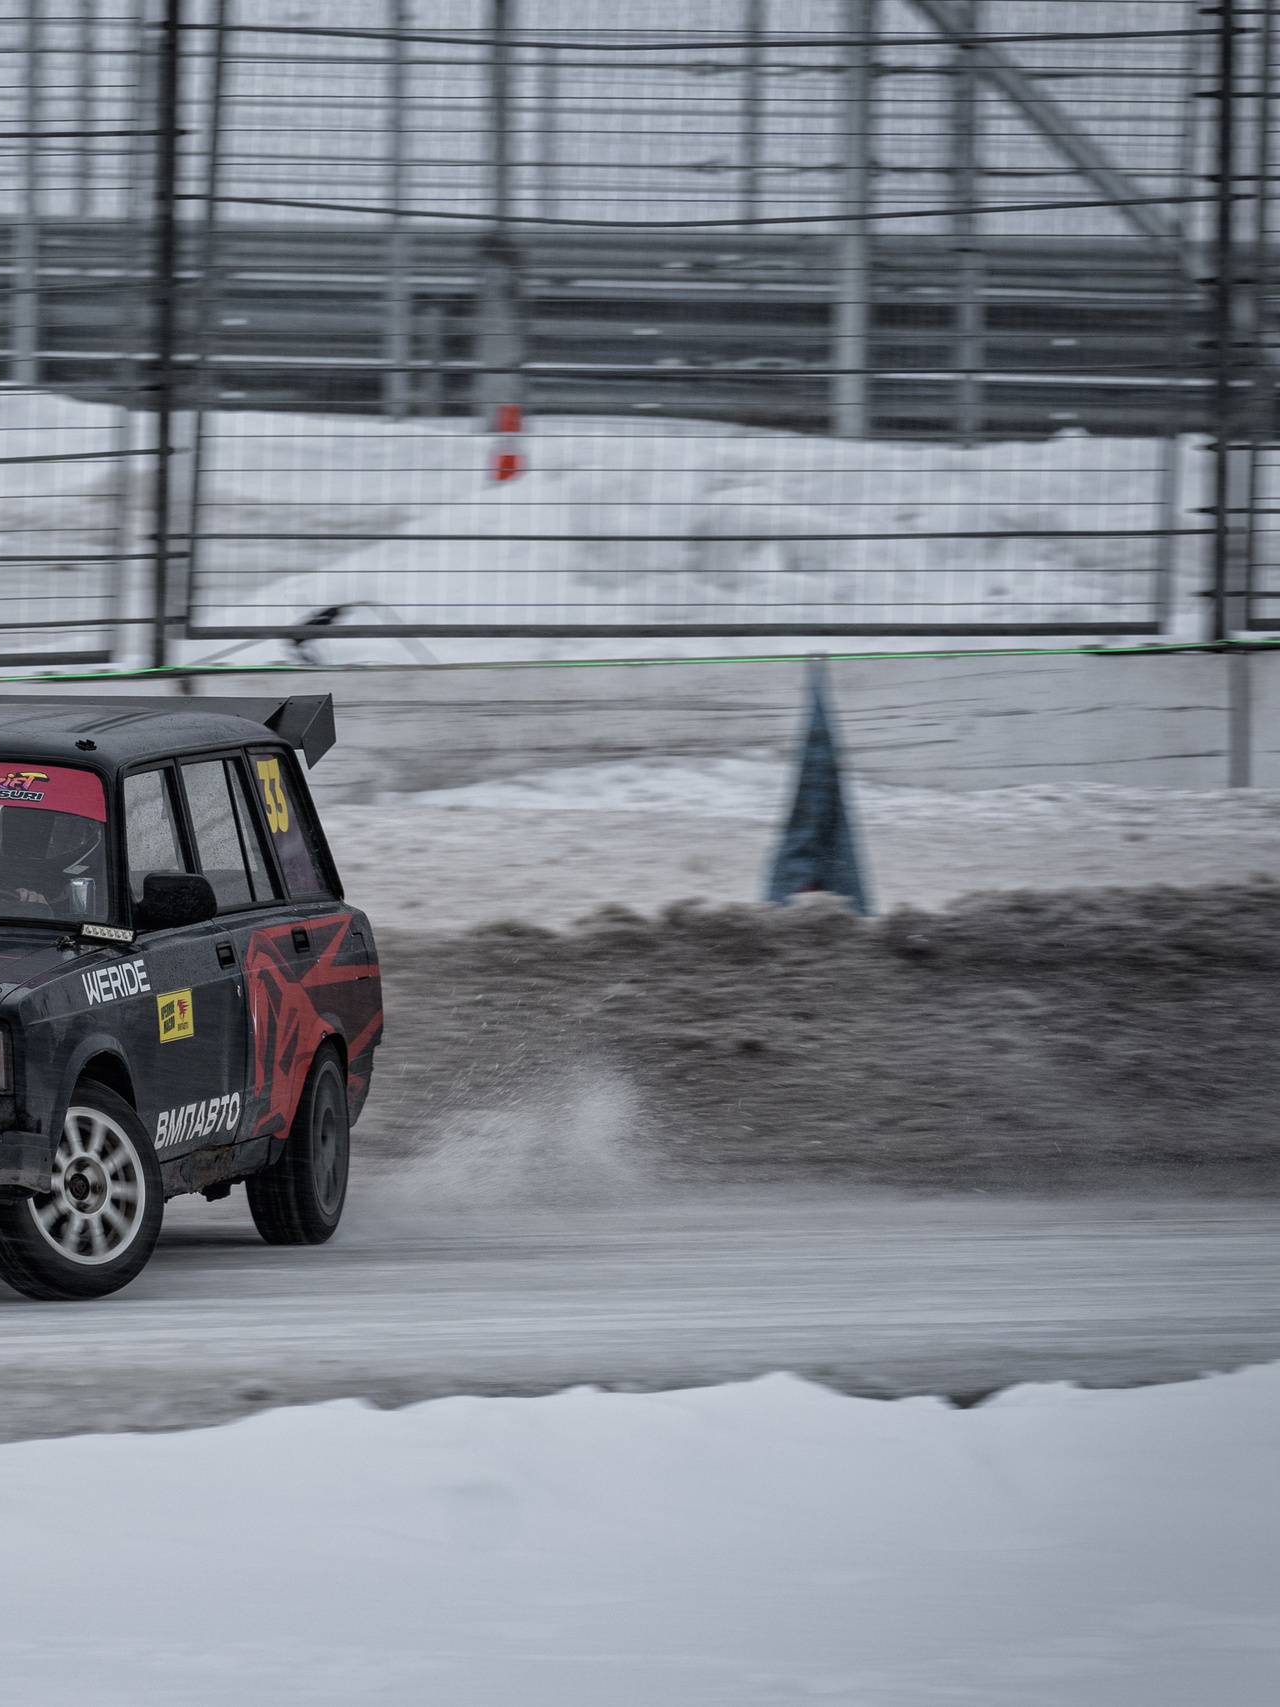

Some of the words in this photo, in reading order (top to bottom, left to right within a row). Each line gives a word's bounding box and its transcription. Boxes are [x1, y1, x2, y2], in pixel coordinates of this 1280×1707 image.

[256, 758, 289, 833] 33
[81, 959, 151, 1005] WERIDE
[154, 1092, 240, 1150] ВМПАВТО
